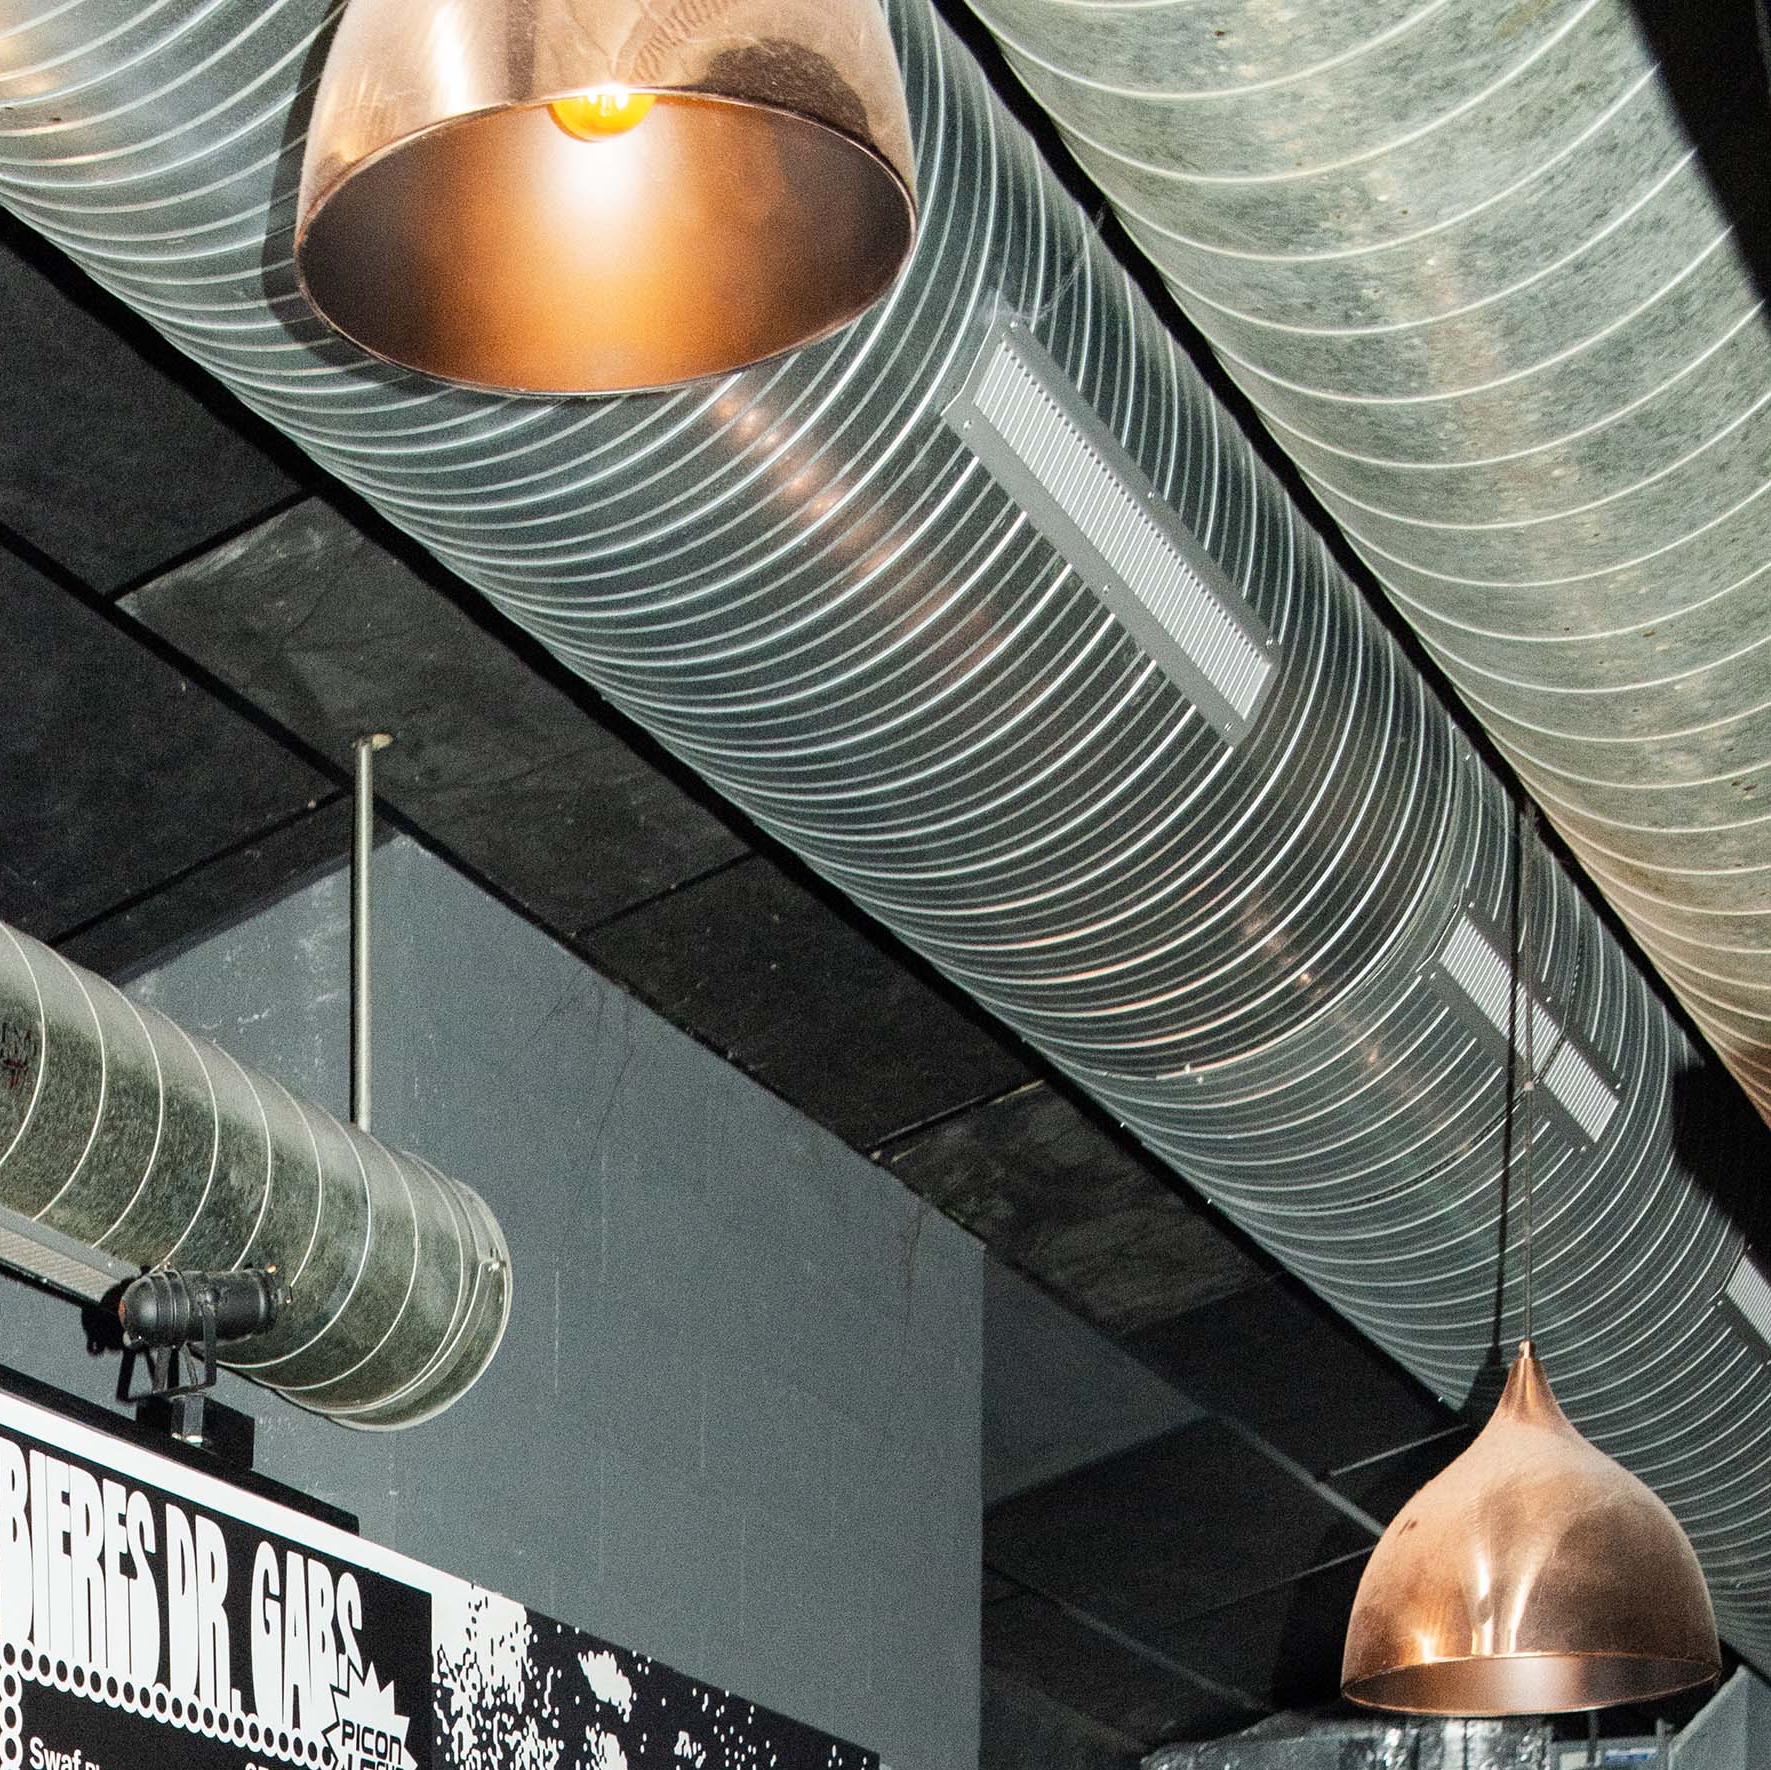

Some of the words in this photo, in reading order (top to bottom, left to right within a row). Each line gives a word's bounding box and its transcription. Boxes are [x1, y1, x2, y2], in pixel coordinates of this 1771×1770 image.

[166, 1504, 242, 1717] DR.
[250, 1540, 365, 1738] GABS
[341, 1719, 402, 1765] PICON
